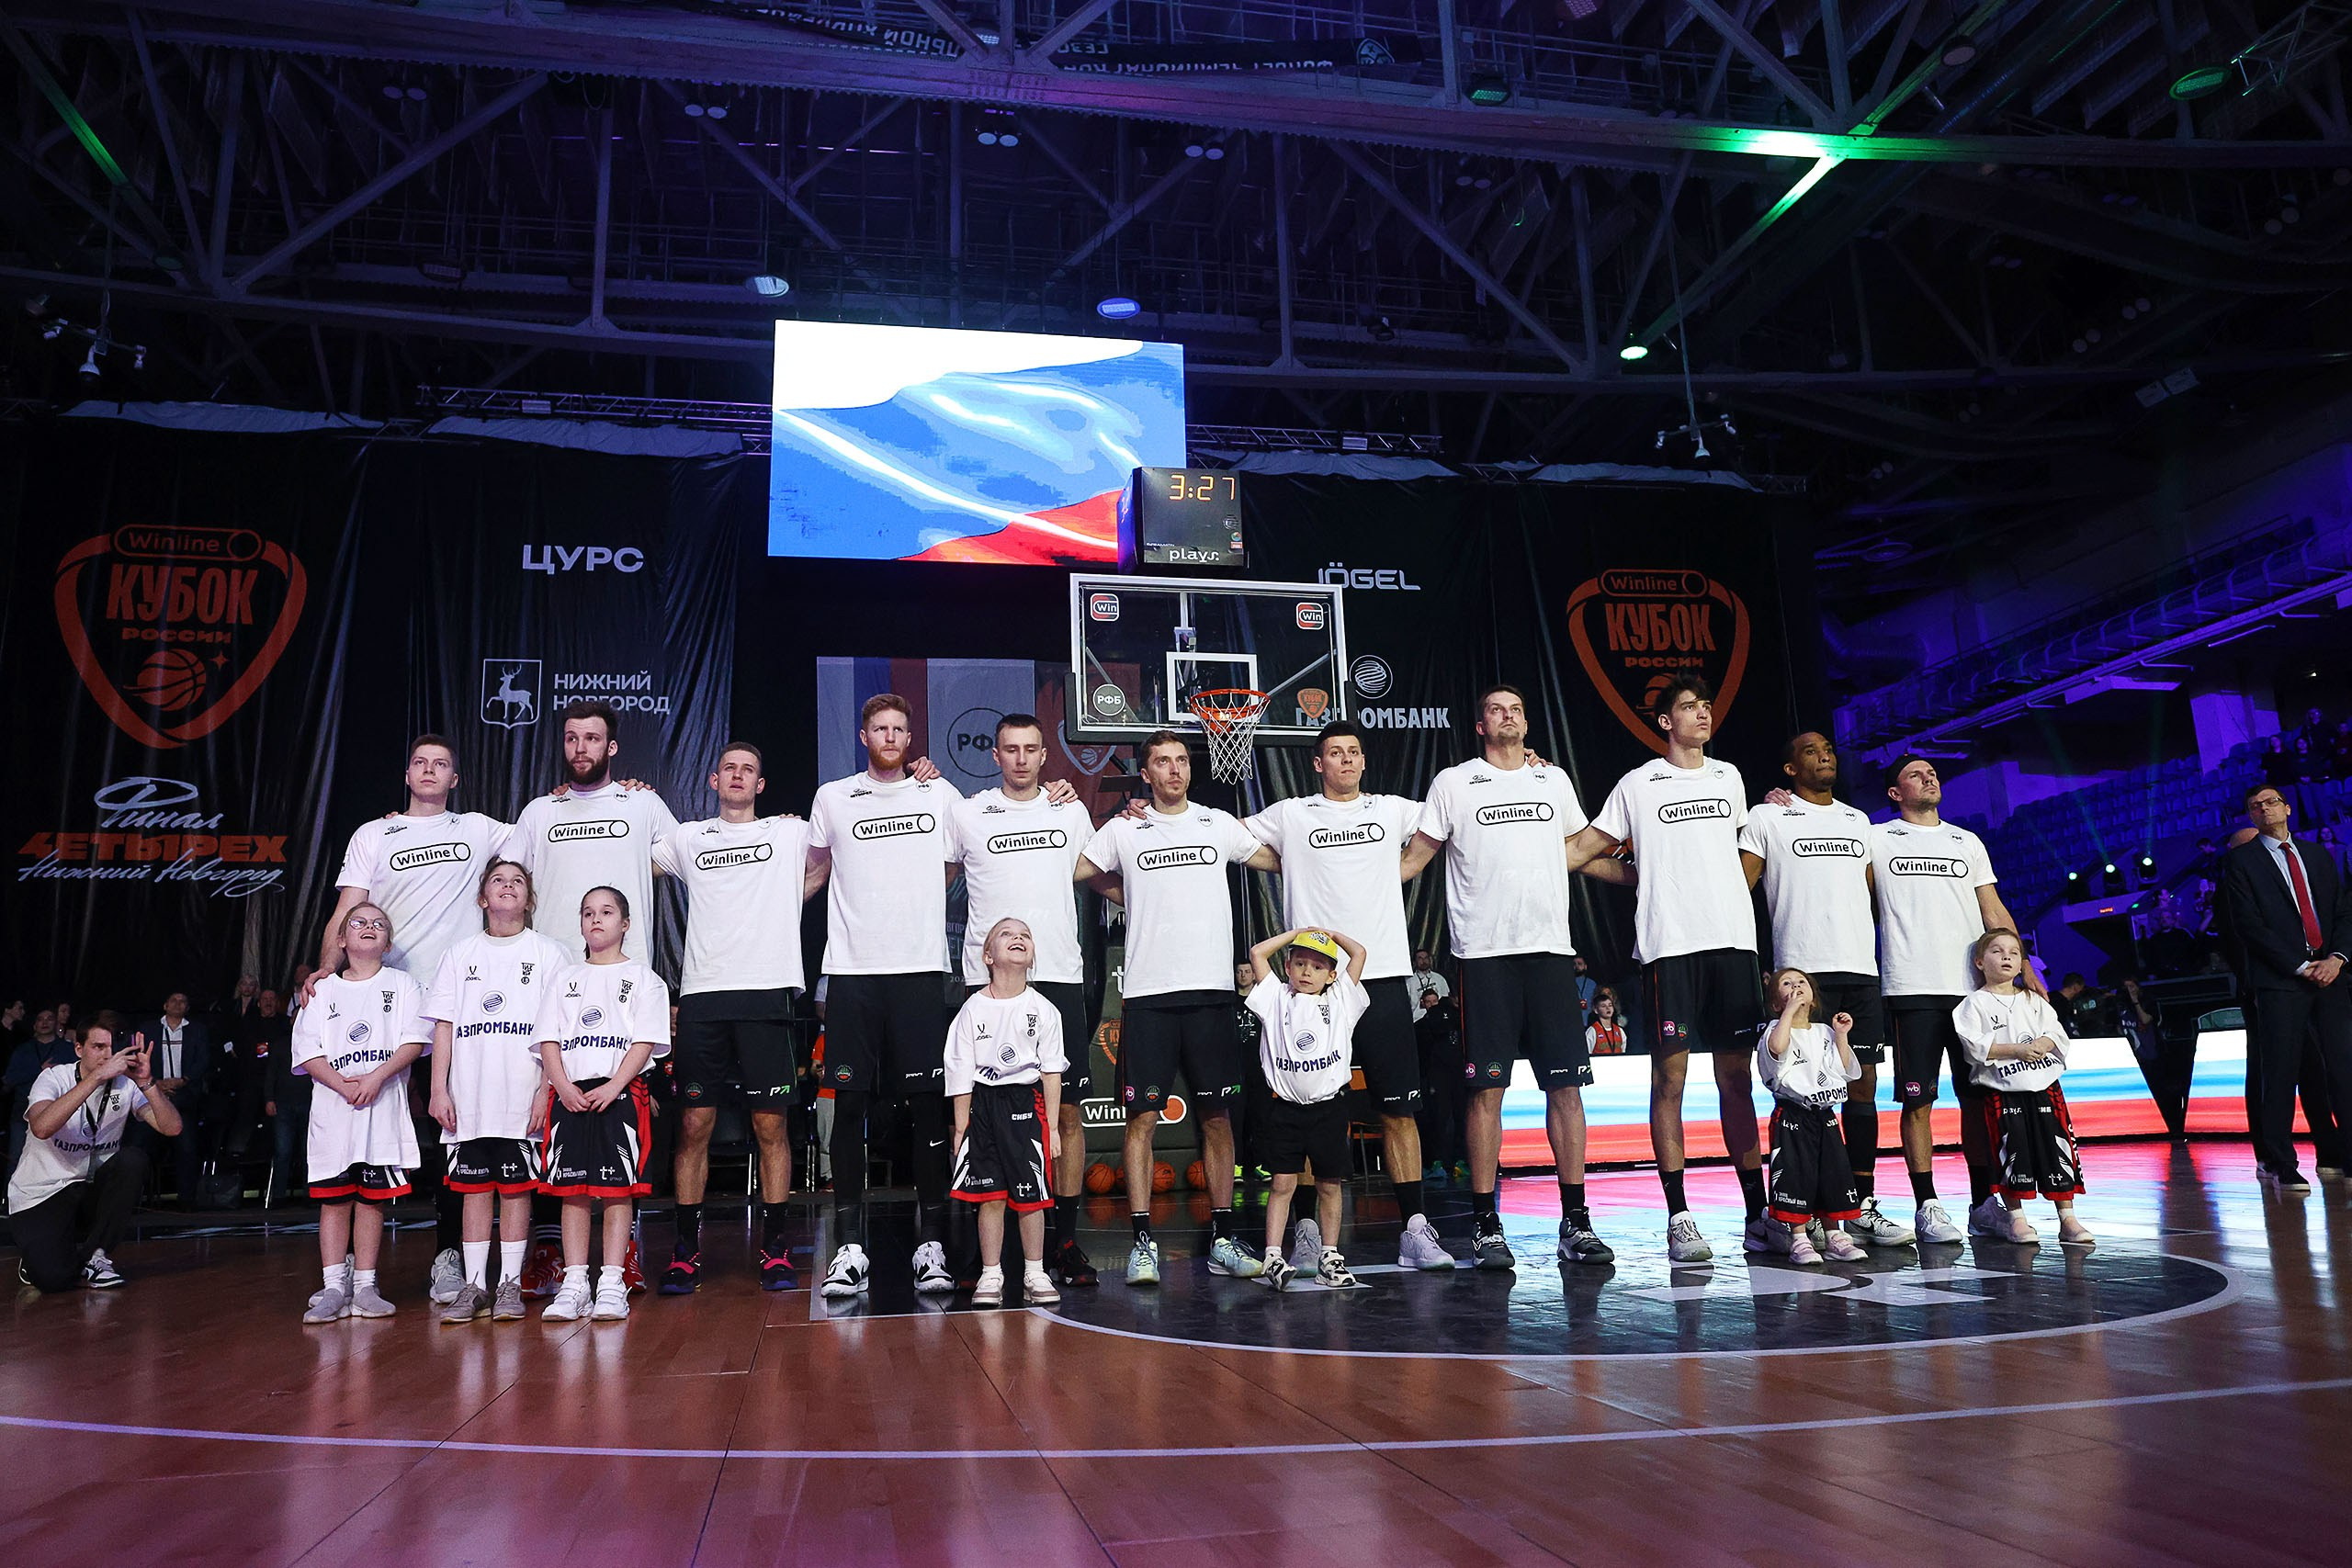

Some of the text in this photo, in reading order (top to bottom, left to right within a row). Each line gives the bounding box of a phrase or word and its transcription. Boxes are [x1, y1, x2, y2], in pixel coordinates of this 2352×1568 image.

[1170, 475, 1235, 501] 3:27
[130, 532, 220, 552] Winline
[523, 545, 644, 575] ЦУРС
[1611, 576, 1677, 591] Winline
[106, 563, 258, 625] КУБОК
[1097, 603, 1117, 613] Win
[1303, 613, 1322, 621] Win
[1605, 603, 1716, 651] КУБОК
[554, 670, 651, 691] НИЖНИЙ
[1097, 695, 1122, 705] РФБ
[957, 734, 994, 751] РФ
[95, 777, 223, 829] Финал
[1483, 807, 1533, 821] Winline
[1665, 804, 1716, 818] Winline
[554, 825, 605, 839] Winline
[860, 819, 913, 836] Winline
[994, 835, 1046, 850] Winline
[1316, 829, 1365, 844] Winline
[1799, 841, 1849, 853] Winline
[396, 848, 451, 867] Winline
[702, 851, 751, 866] Winline
[1143, 851, 1196, 865] Winline
[18, 848, 286, 897] Нижний Новгород
[1895, 861, 1948, 873] Winline
[457, 1021, 535, 1039] АЗПРОМБАНК
[1085, 1104, 1126, 1120] Winl
